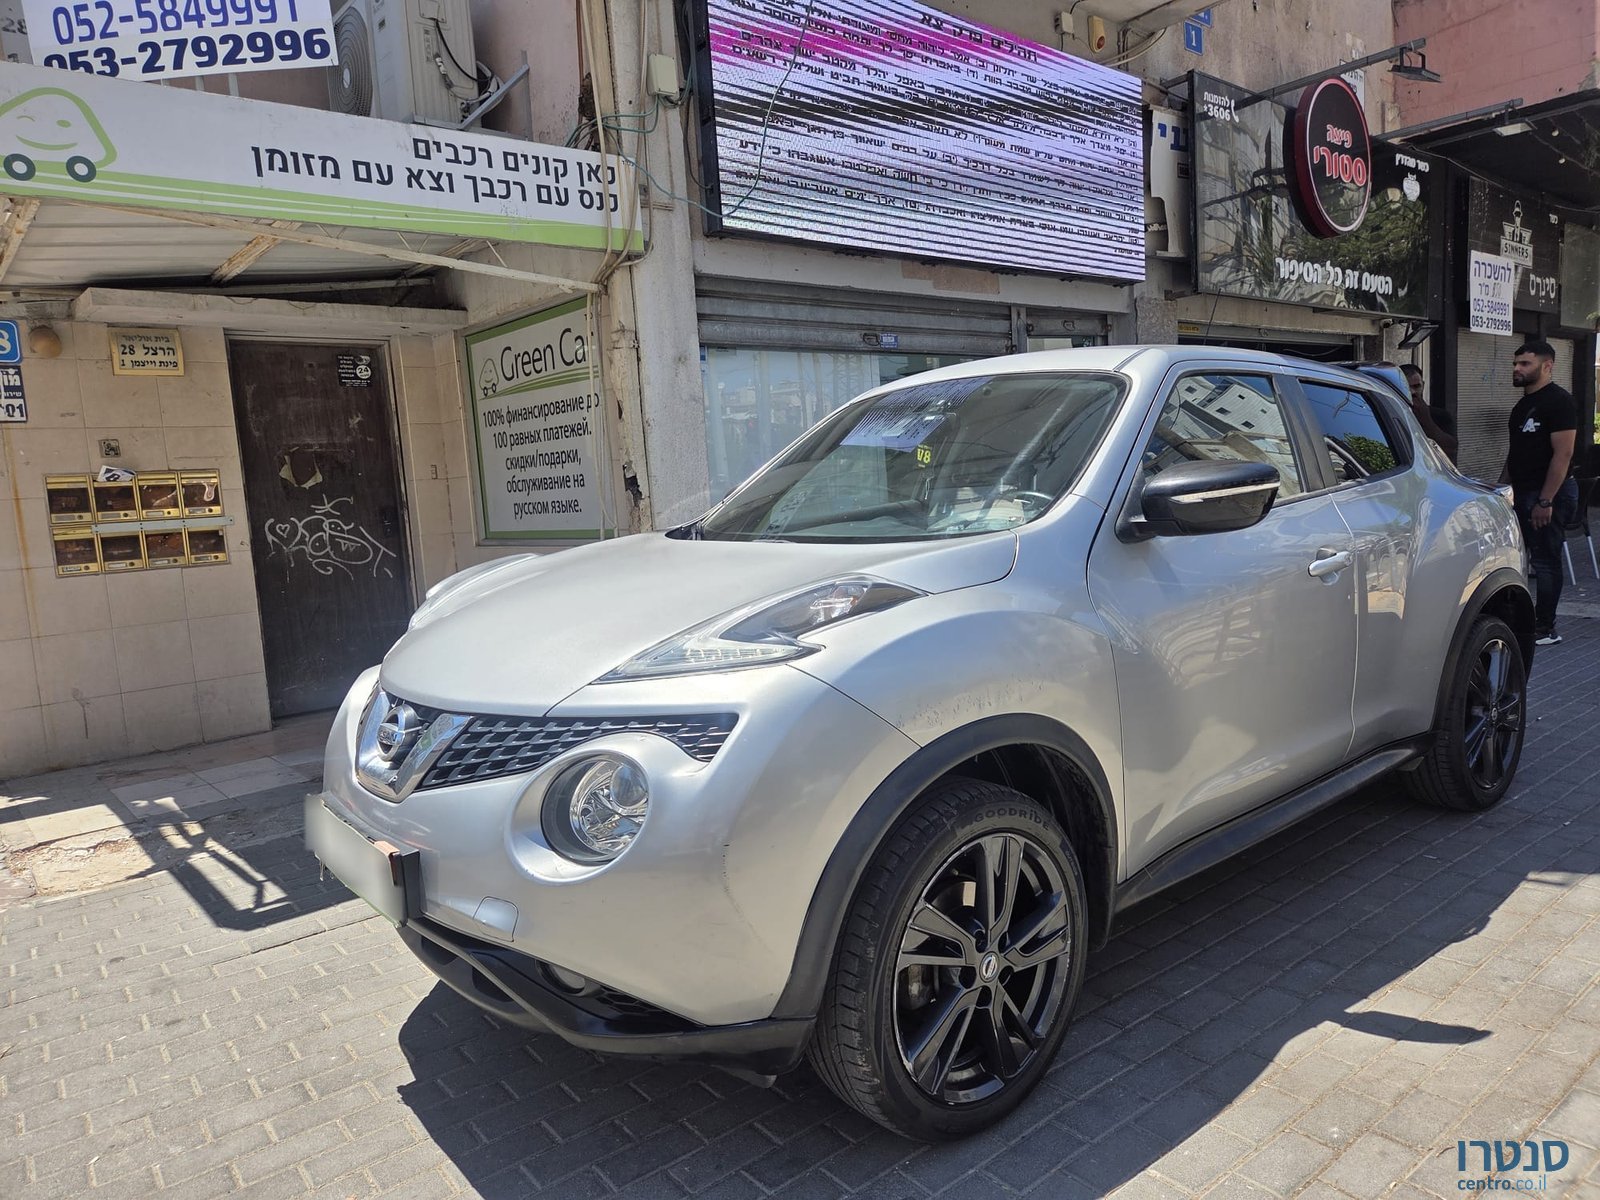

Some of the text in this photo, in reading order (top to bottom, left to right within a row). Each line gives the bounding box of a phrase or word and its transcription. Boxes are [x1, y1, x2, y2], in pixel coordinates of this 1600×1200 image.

[919, 12, 1037, 62] תהילים פרק צא
[1191, 30, 1197, 47] 1
[1204, 91, 1230, 108] להזמנות
[1326, 123, 1353, 149] פיצה
[412, 137, 616, 188] כאן קונים רכבים
[1313, 145, 1367, 187] סטורי
[251, 146, 619, 213] כנס עם רכבך וצא עם מזומן
[1504, 242, 1529, 259] SINNERS
[1275, 257, 1322, 284] הסיפור
[1326, 260, 1343, 287] כל
[1345, 269, 1359, 290] זה
[1474, 260, 1512, 283] להשכרה
[1473, 298, 1510, 316] 052-5849991
[1471, 315, 1512, 332] 053-2792996
[121, 344, 176, 356] הרצל 28
[500, 327, 594, 382] Green Ca
[159, 360, 178, 368] פינת
[483, 408, 506, 428] 100%
[506, 395, 585, 427] финансирование
[493, 417, 592, 451] 100 равных платежей.
[505, 448, 582, 474] скидки/подарки,
[506, 471, 585, 497] обслуживание на
[513, 498, 582, 520] русском языке.
